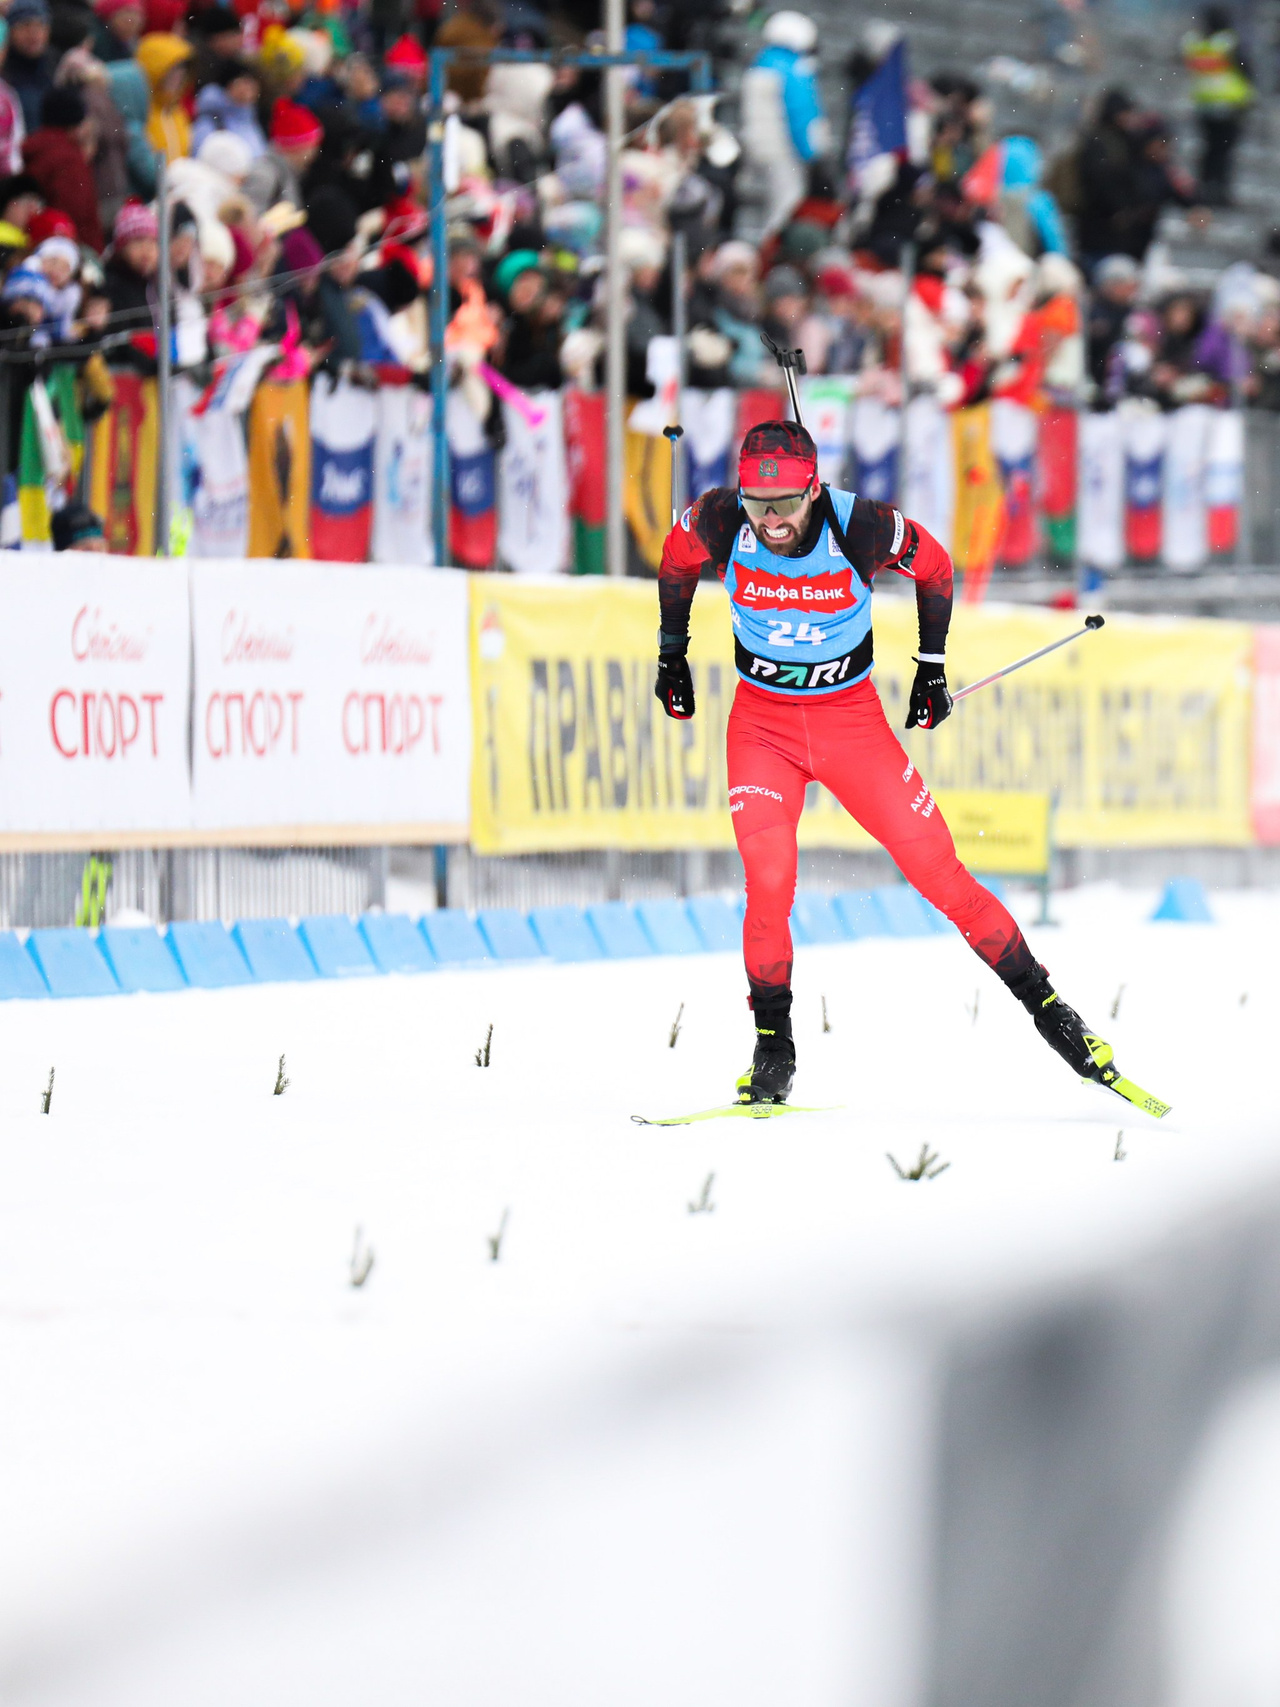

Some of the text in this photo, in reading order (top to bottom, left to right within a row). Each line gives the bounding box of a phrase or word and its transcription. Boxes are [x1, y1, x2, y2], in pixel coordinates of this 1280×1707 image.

[743, 582, 845, 601] Альфа Банк
[768, 620, 827, 647] 24
[750, 656, 851, 688] PARI
[50, 687, 164, 760] СПОРТ
[206, 690, 304, 759] СПОРТ
[342, 690, 444, 756] СПОРТ
[728, 785, 783, 803] ОЯРСКИЙ
